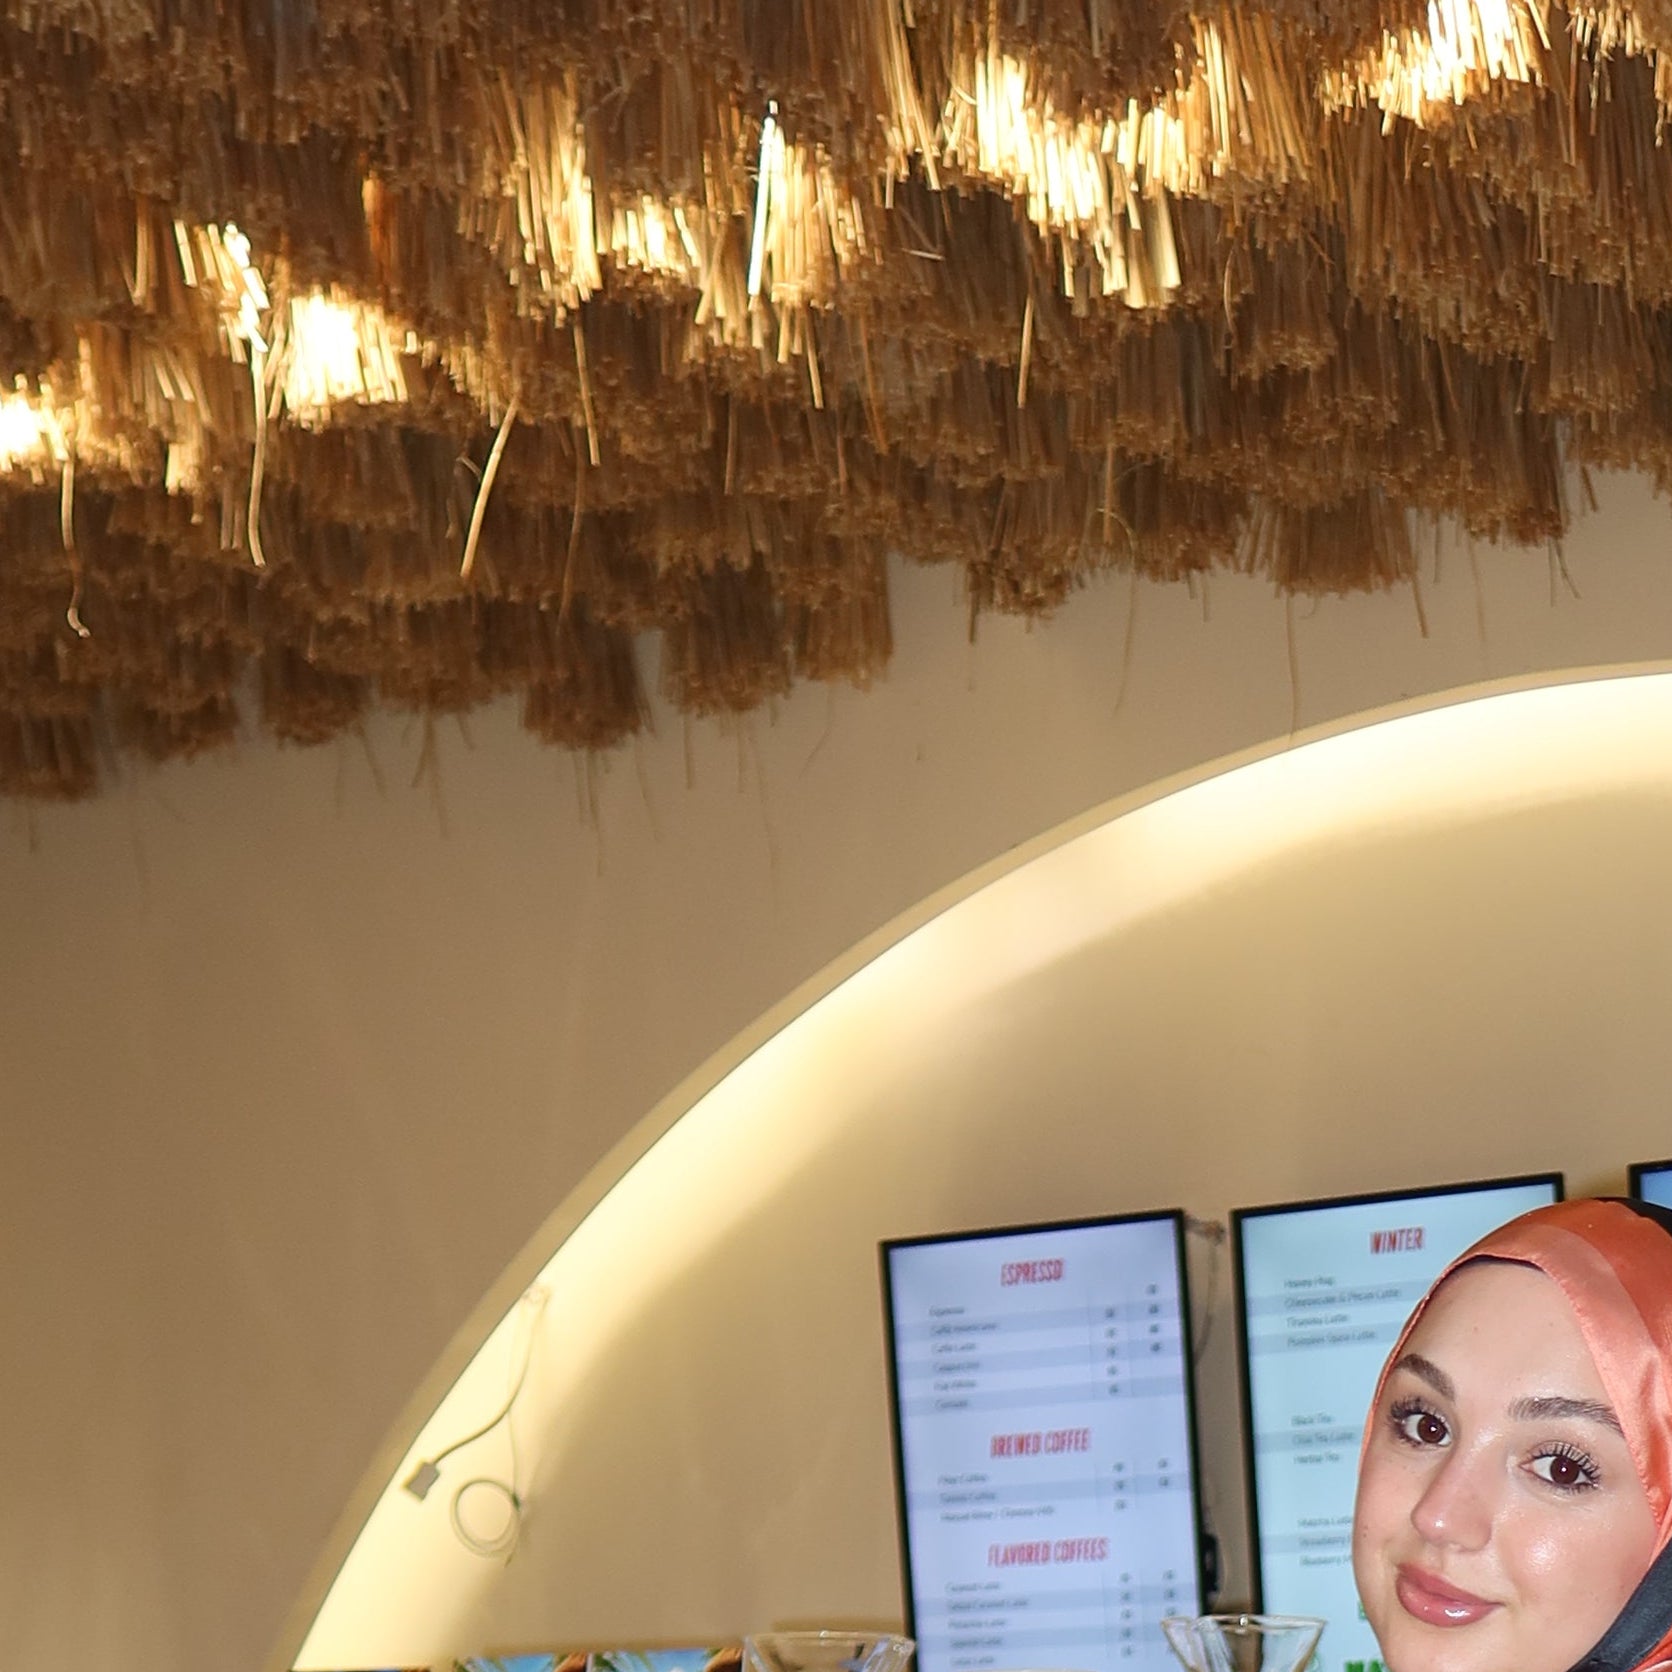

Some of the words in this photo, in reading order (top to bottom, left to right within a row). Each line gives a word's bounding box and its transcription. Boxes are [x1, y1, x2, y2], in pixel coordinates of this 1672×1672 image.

[1370, 1226, 1424, 1254] WINTER
[1001, 1258, 1065, 1286] ESPRESSO
[991, 1431, 1042, 1459] BREWED
[1045, 1428, 1090, 1453] COFFEE
[988, 1540, 1050, 1567] FLAVORED
[1053, 1537, 1109, 1562] COFFEES
